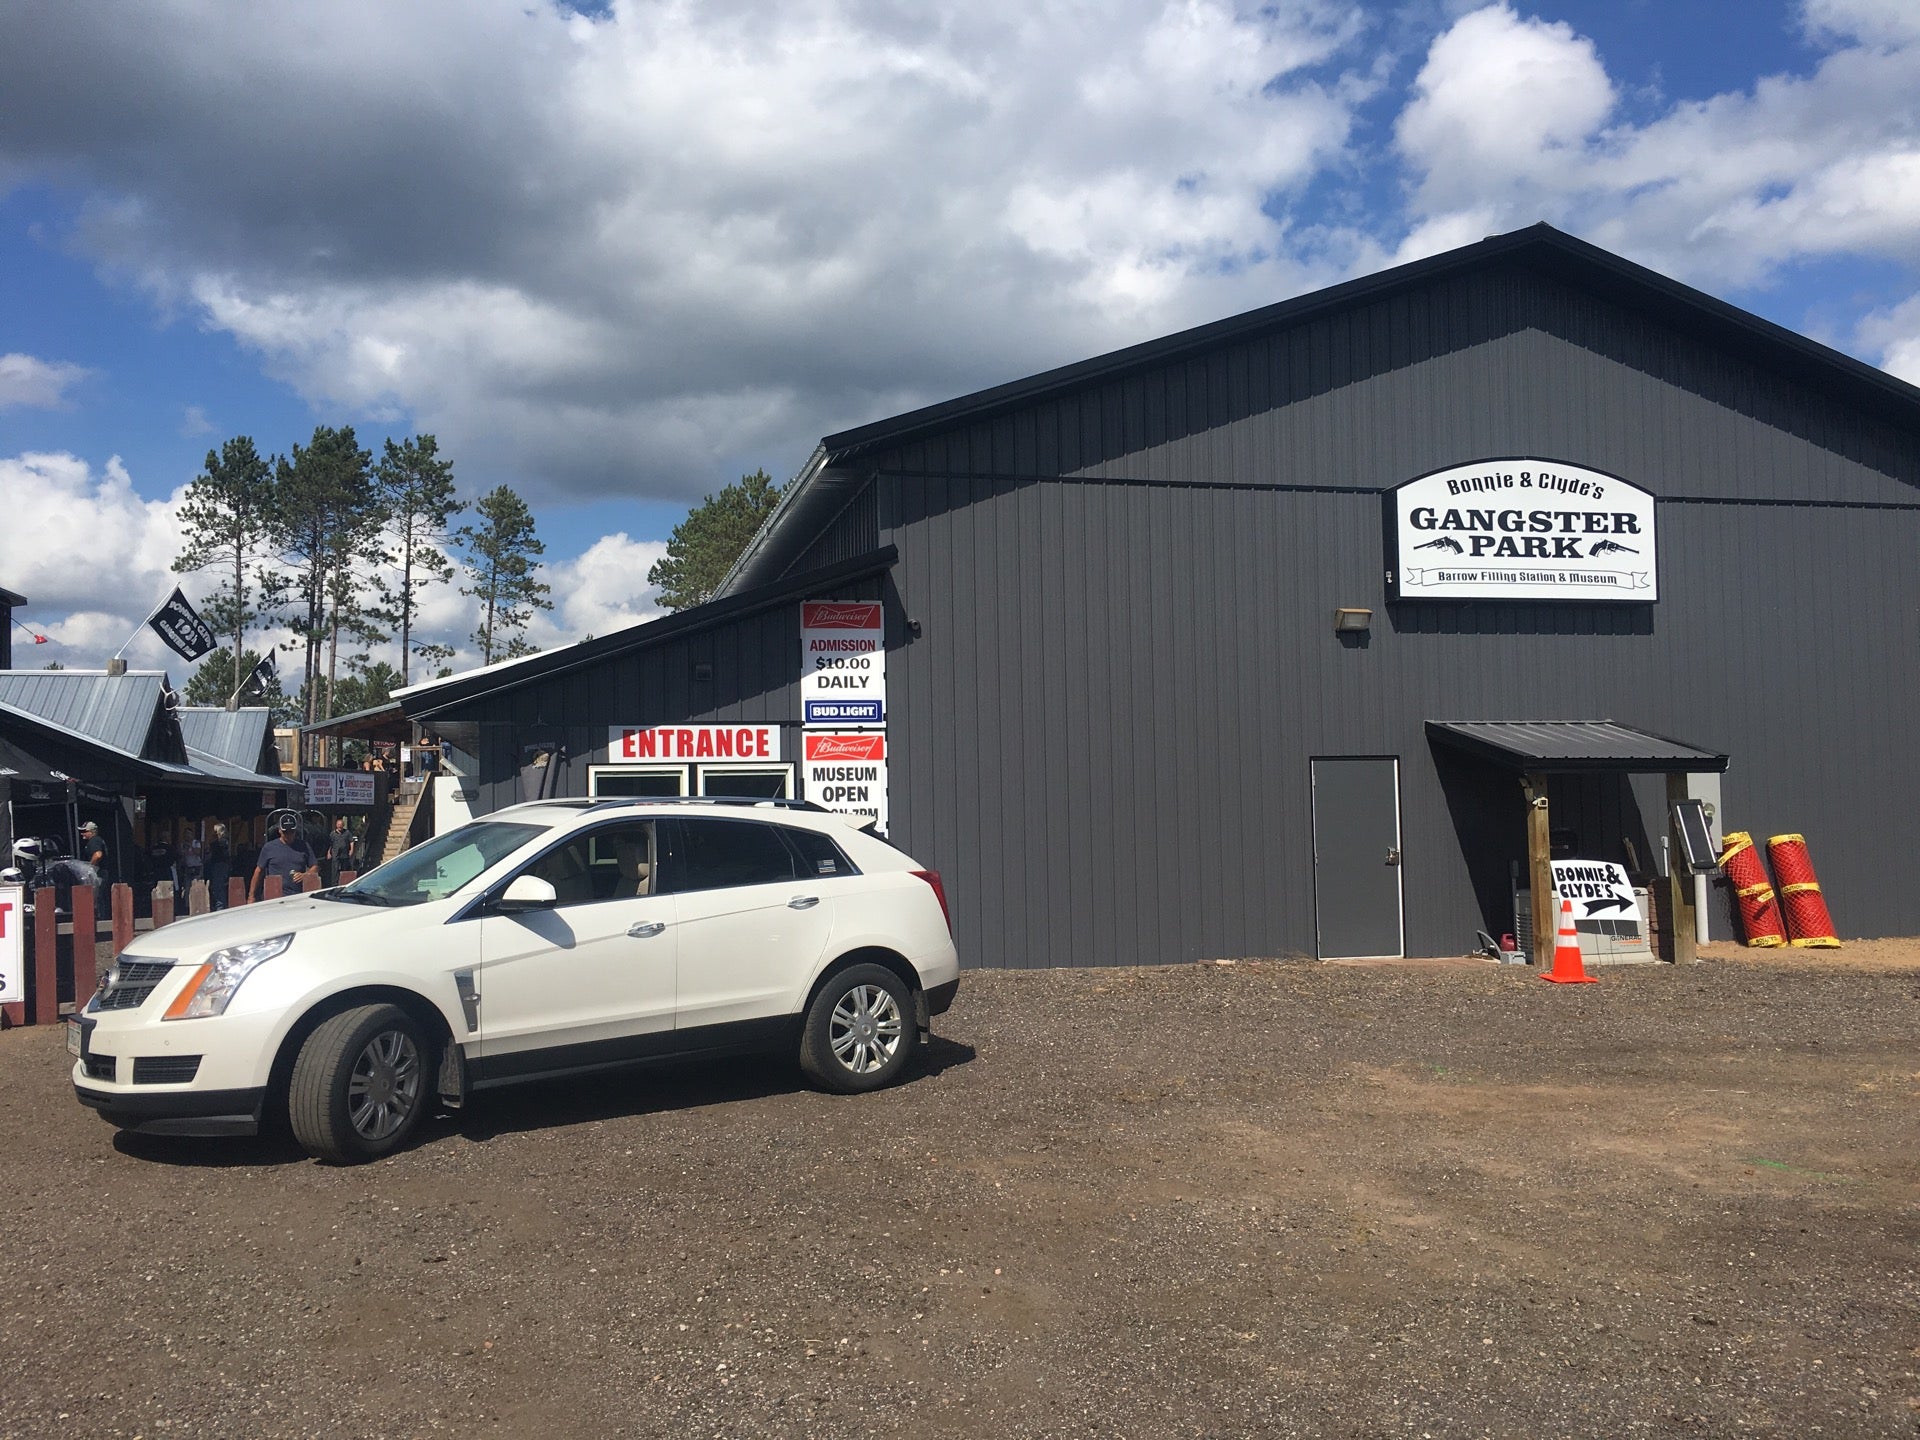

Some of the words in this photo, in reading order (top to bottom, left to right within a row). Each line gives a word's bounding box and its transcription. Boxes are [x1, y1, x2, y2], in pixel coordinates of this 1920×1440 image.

[1446, 472, 1513, 495] Bonnie
[1520, 472, 1532, 487] &
[1539, 473, 1604, 499] Clyde's
[1409, 507, 1641, 534] GANGSTER
[1469, 535, 1583, 558] PARK
[1438, 571, 1478, 581] Barrow
[1481, 571, 1517, 582] Filling
[1520, 572, 1556, 583] Station
[1558, 573, 1566, 581] &
[1569, 573, 1617, 584] Museum
[816, 610, 868, 621] Budweiser
[810, 640, 876, 651] ADMISSION
[816, 656, 870, 670] $10.00
[817, 675, 870, 689] DAILY
[812, 706, 839, 716] BUD
[840, 706, 875, 716] LIGHT
[622, 729, 769, 758] ENTRANCE
[817, 742, 870, 753] Budweiser
[812, 766, 877, 782] MUSEUM
[822, 786, 869, 802] OPEN
[1559, 883, 1614, 898] CLYDE'S
